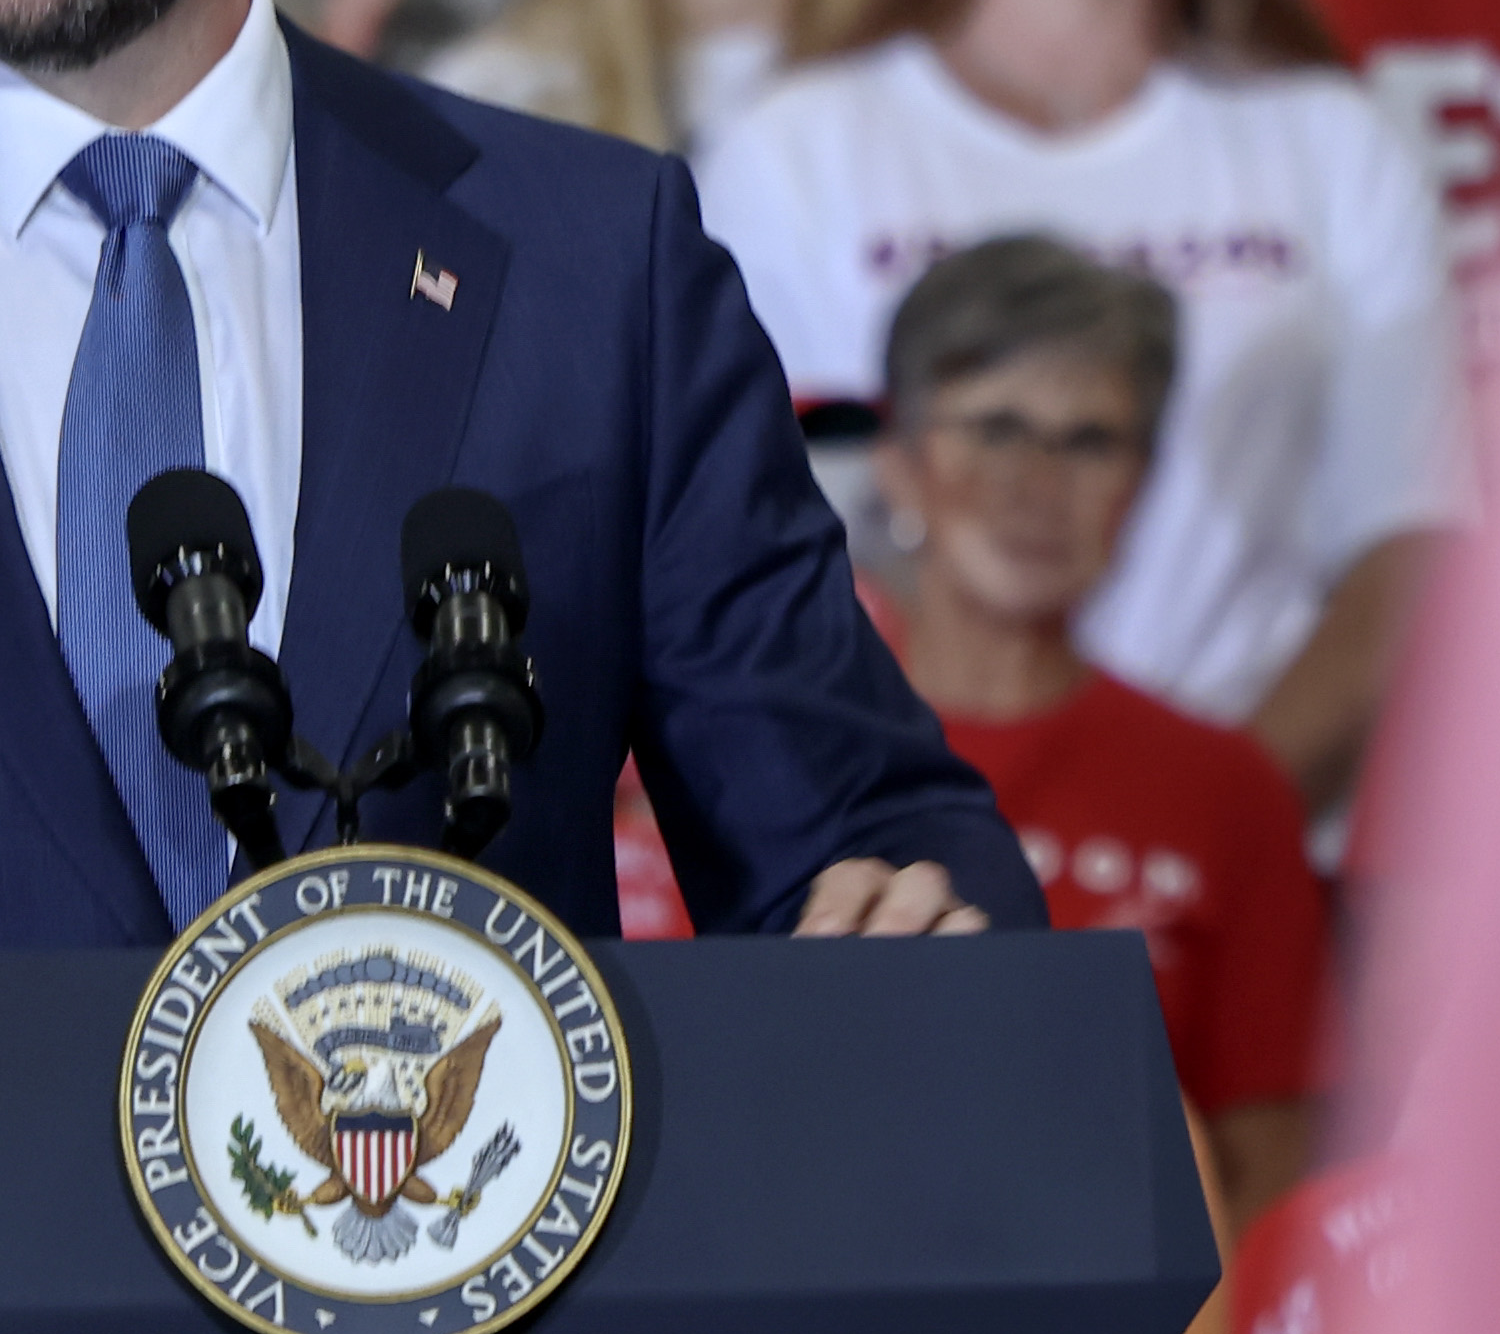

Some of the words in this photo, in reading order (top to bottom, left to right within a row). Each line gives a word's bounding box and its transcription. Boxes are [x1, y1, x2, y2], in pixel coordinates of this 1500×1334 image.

[295, 870, 351, 916] OF
[372, 867, 459, 918] THE
[134, 892, 268, 1193] PRESIDENT
[483, 897, 617, 1104] UNITED
[174, 1206, 288, 1326] VICE
[459, 1135, 612, 1325] STATES
